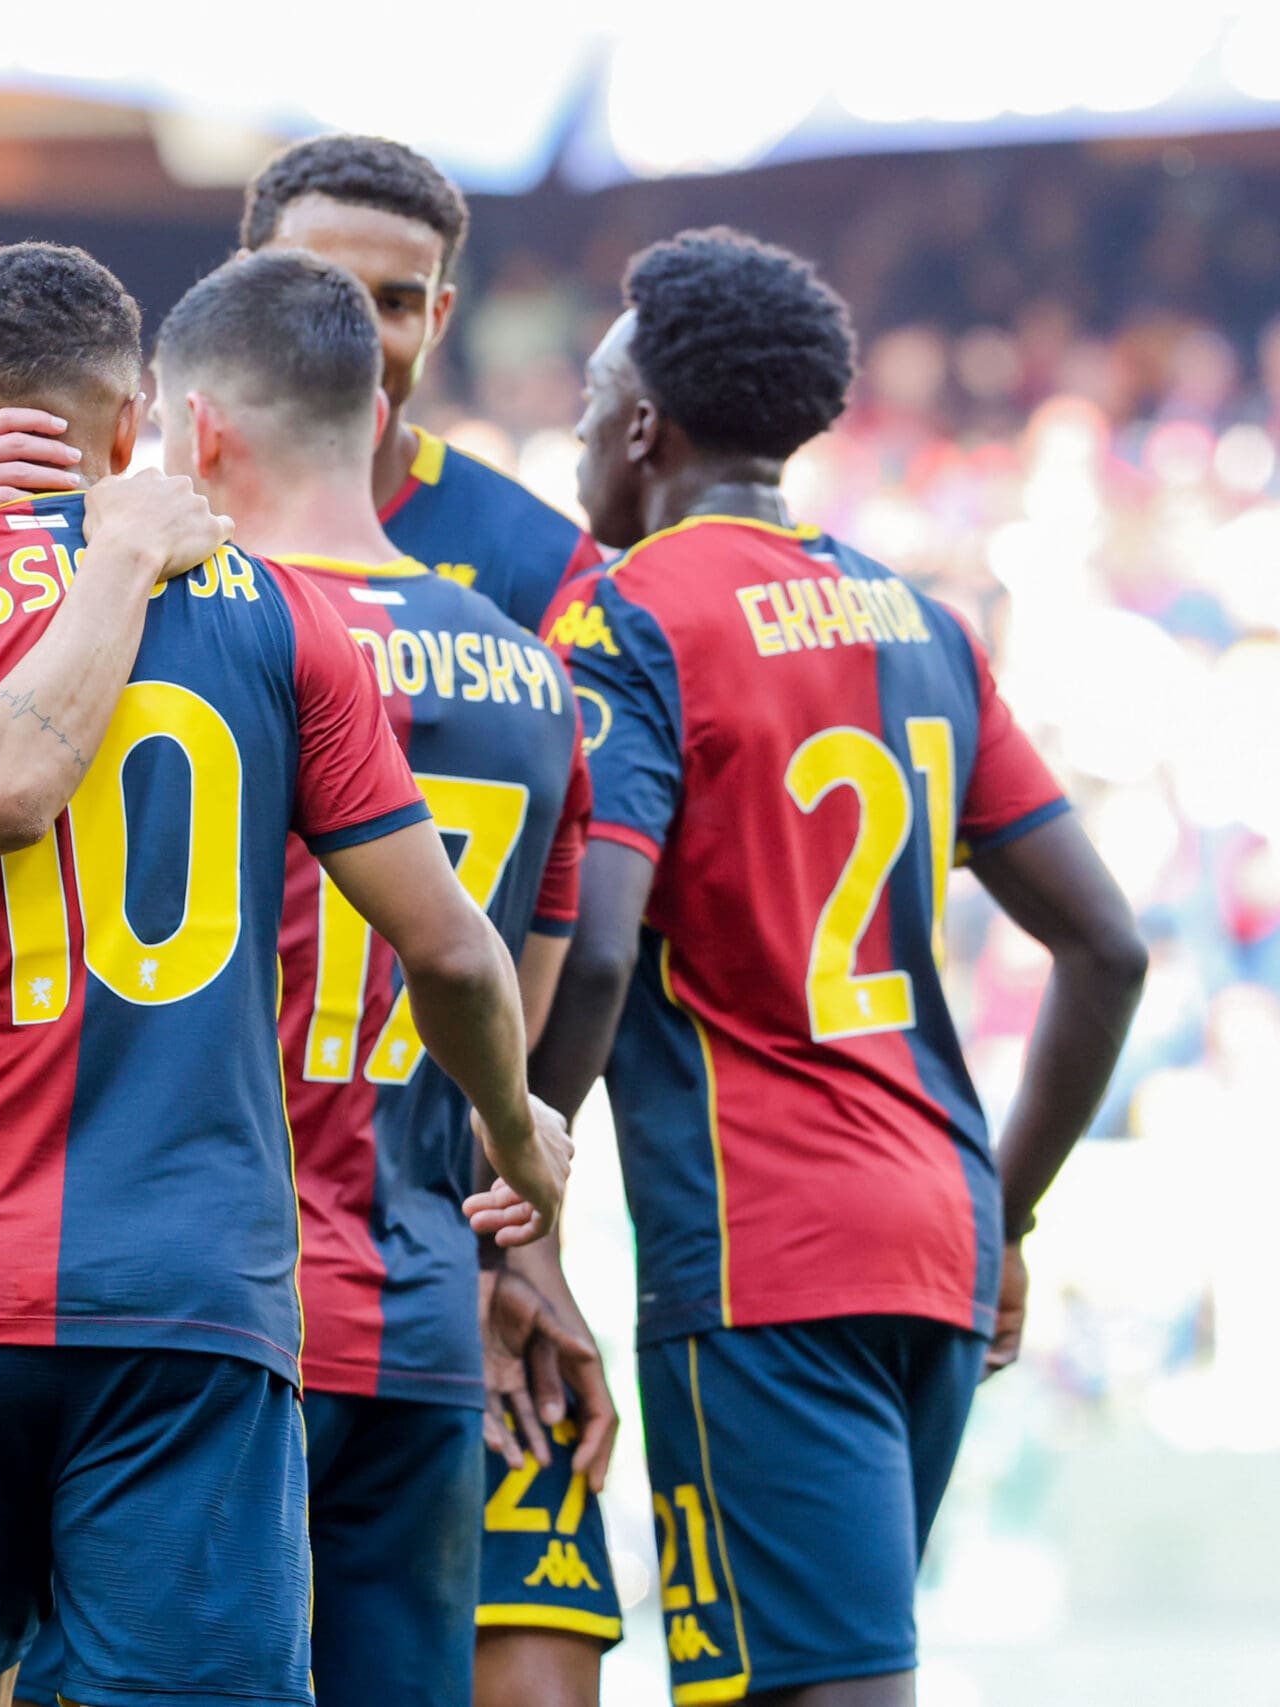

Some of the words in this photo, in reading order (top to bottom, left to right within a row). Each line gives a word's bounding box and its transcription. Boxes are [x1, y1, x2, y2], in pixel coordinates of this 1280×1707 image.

[187, 545, 260, 602] JR
[784, 717, 956, 1044] 21
[651, 1483, 718, 1611] 21
